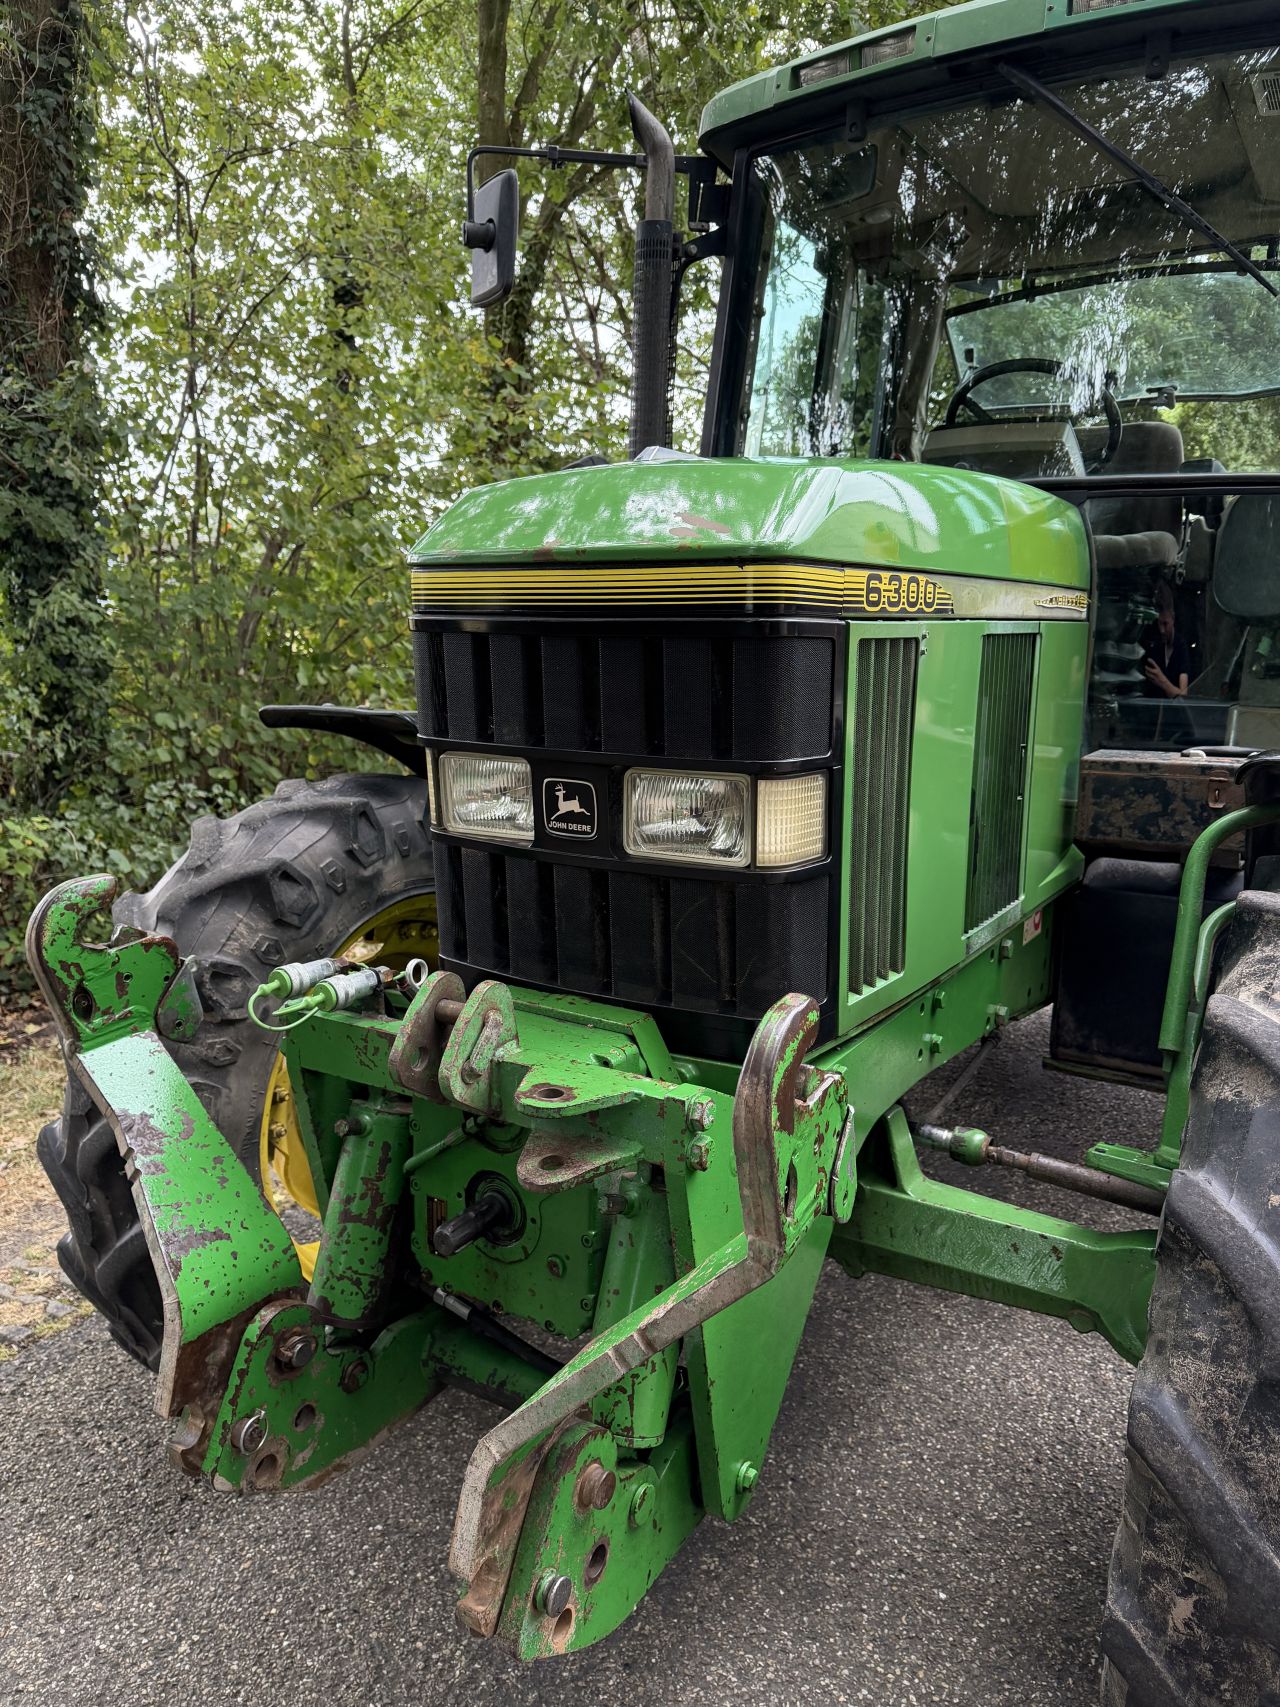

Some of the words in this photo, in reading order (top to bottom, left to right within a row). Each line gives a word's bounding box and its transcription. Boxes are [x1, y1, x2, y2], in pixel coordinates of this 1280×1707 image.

[865, 573, 937, 611] 6300
[548, 820, 567, 830] JOHN
[568, 822, 592, 833] DEERE
